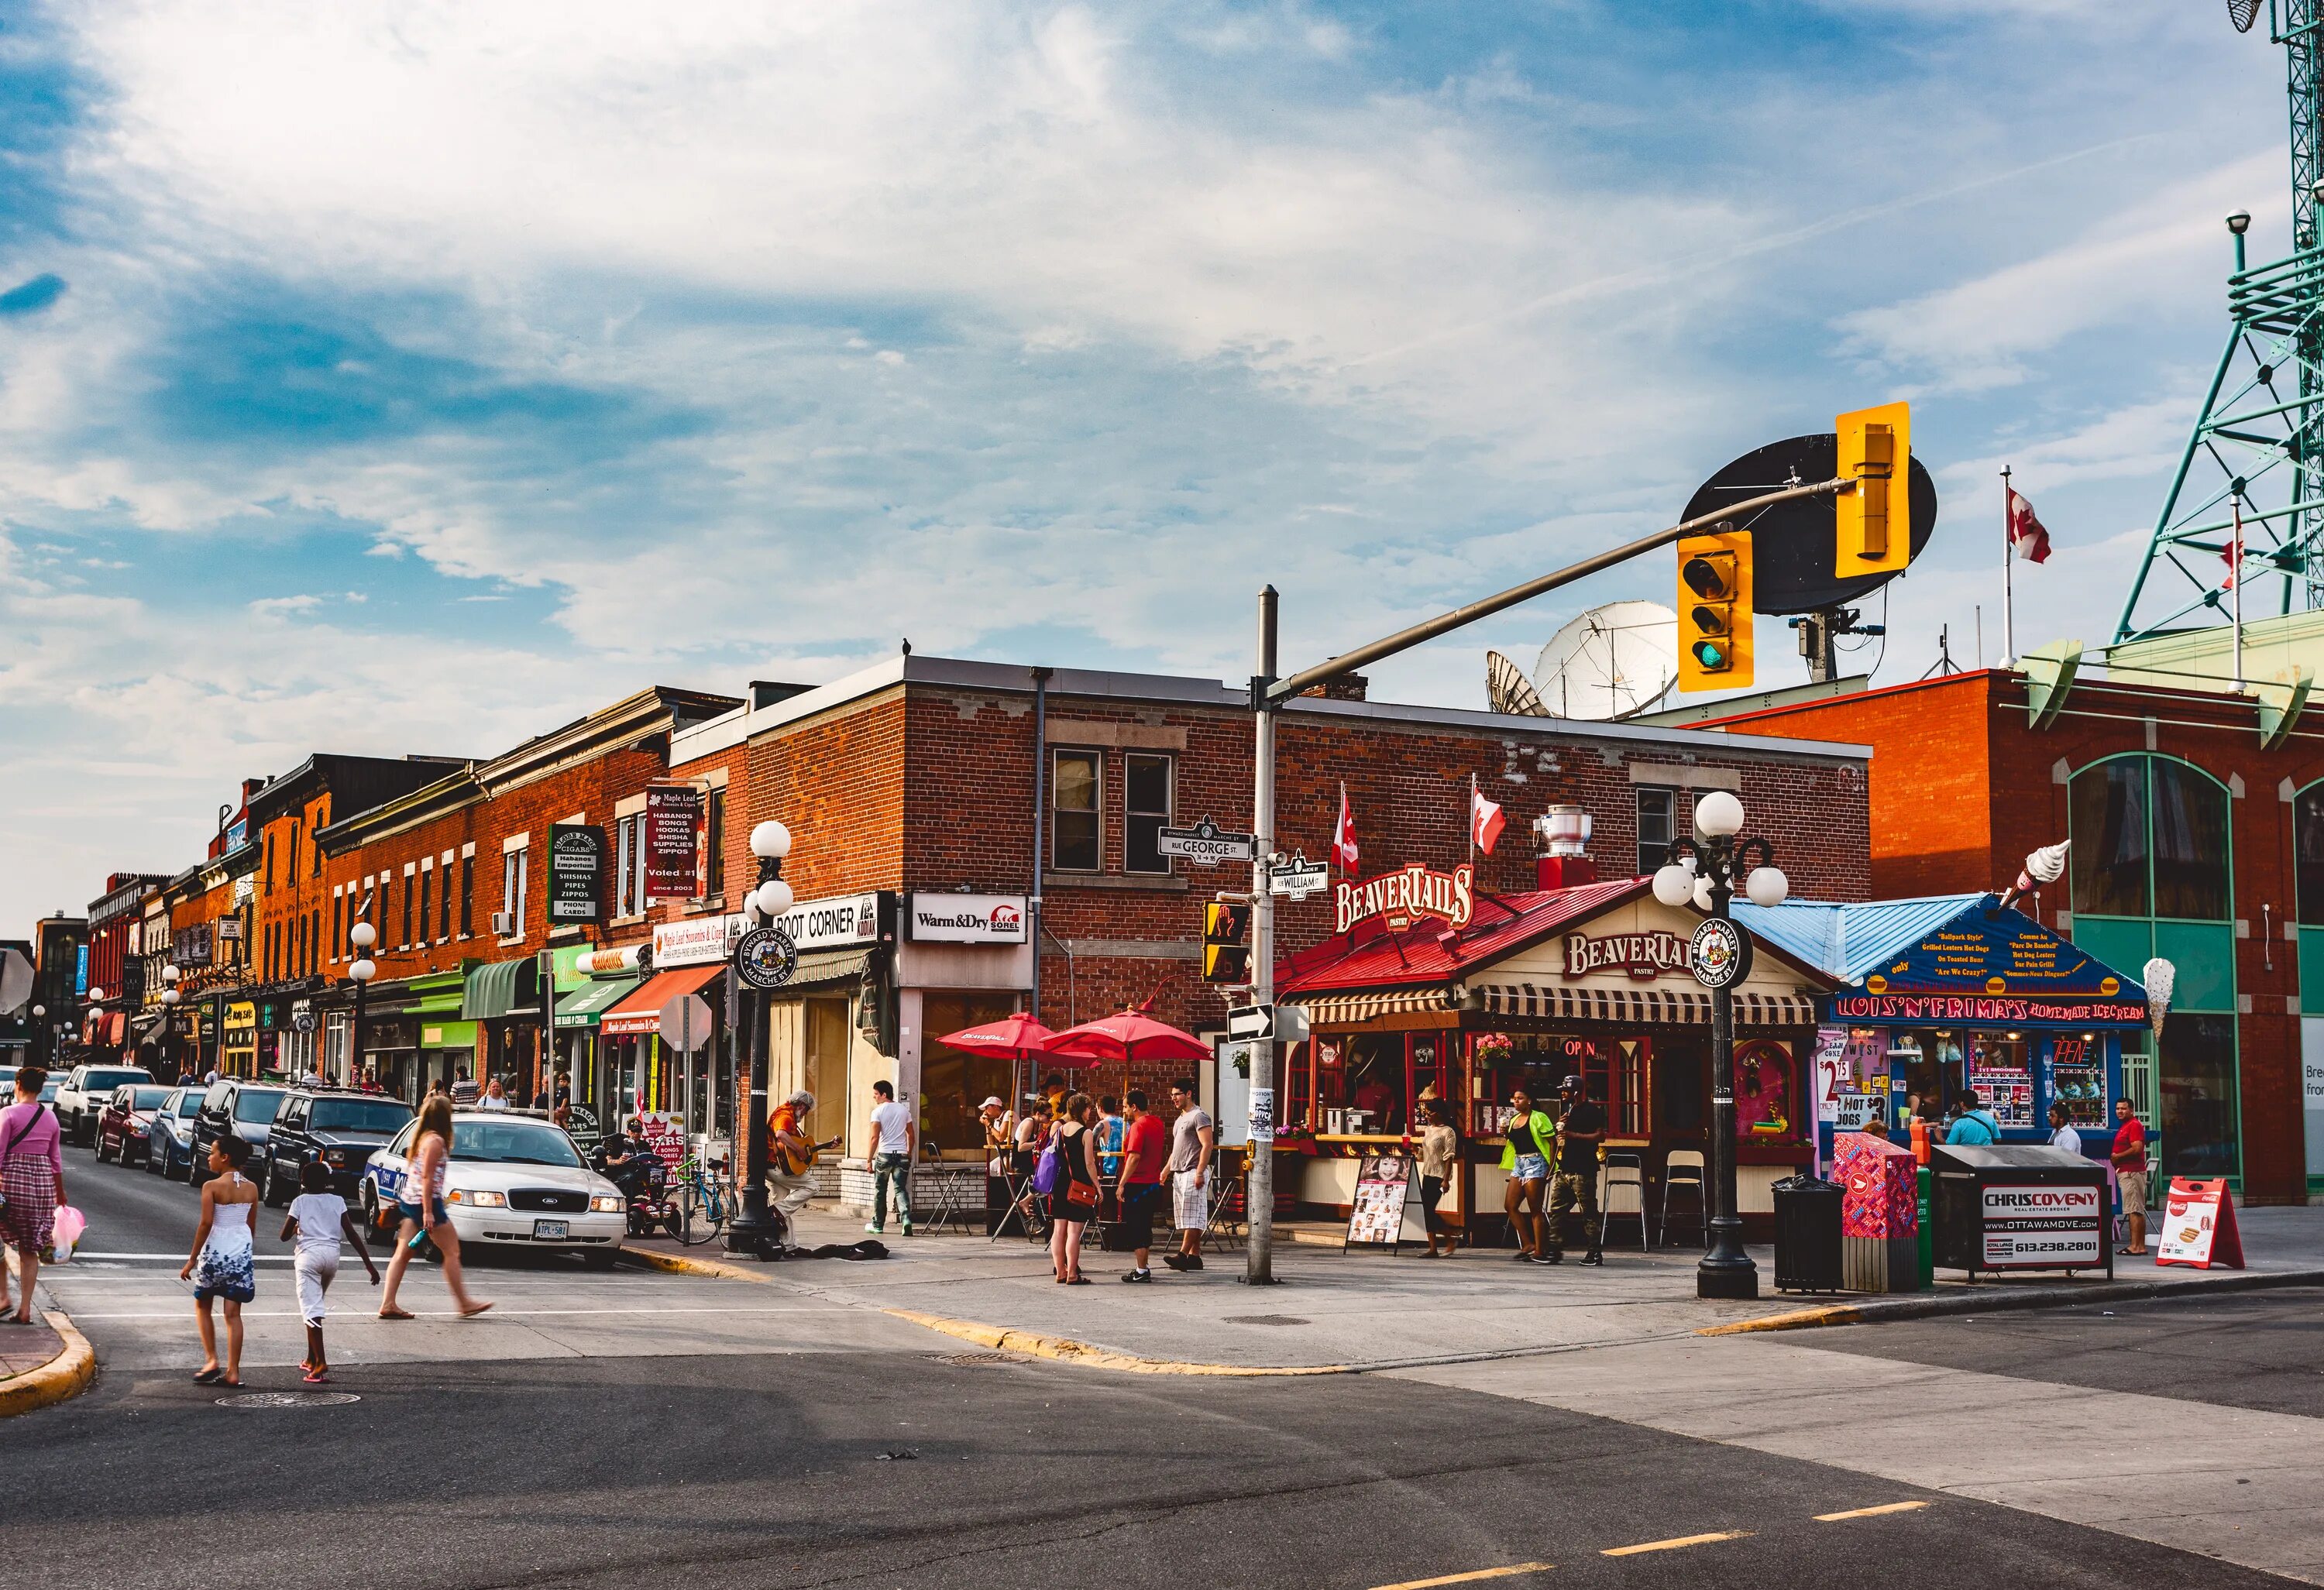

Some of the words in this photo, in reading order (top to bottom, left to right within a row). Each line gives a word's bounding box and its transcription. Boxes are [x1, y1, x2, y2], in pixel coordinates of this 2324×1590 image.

[664, 794, 681, 803] Maple
[555, 833, 576, 850] GLOBE
[1183, 840, 1229, 855] GEORGE
[1284, 877, 1315, 888] WILLIAM
[1336, 867, 1471, 933] BEAVERTAILS
[809, 907, 854, 938] CORNER
[857, 919, 876, 937] KODIAK
[1389, 917, 1408, 927] PASTRY
[664, 931, 676, 949] Maple
[676, 929, 685, 945] Leaf
[686, 929, 706, 944] Souvenirs
[706, 926, 710, 941] &
[1692, 923, 1713, 954] BYWARD
[1714, 923, 1737, 952] MARKET
[744, 932, 768, 957] BYWARD
[770, 932, 794, 959] MARKET
[1975, 945, 1989, 953] Dogs
[1724, 965, 1733, 979] BY
[1892, 961, 1909, 974] only
[779, 970, 788, 980] BY
[2030, 1003, 2091, 1021] HOMEMADE
[607, 1022, 619, 1033] Maple
[619, 1021, 627, 1032] Leaf
[627, 1020, 645, 1032] Souvenirs
[2306, 1065, 2324, 1078] Bre
[1844, 1096, 1865, 1111] HOT
[574, 1107, 596, 1123] MAGS
[1838, 1141, 1855, 1157] P9A
[1834, 1152, 1845, 1166] H9X
[1851, 1207, 1865, 1221] M6S
[537, 1225, 552, 1235] ATPL
[555, 1226, 566, 1235] 581
[2015, 1241, 2096, 1252] 613.238.2801
